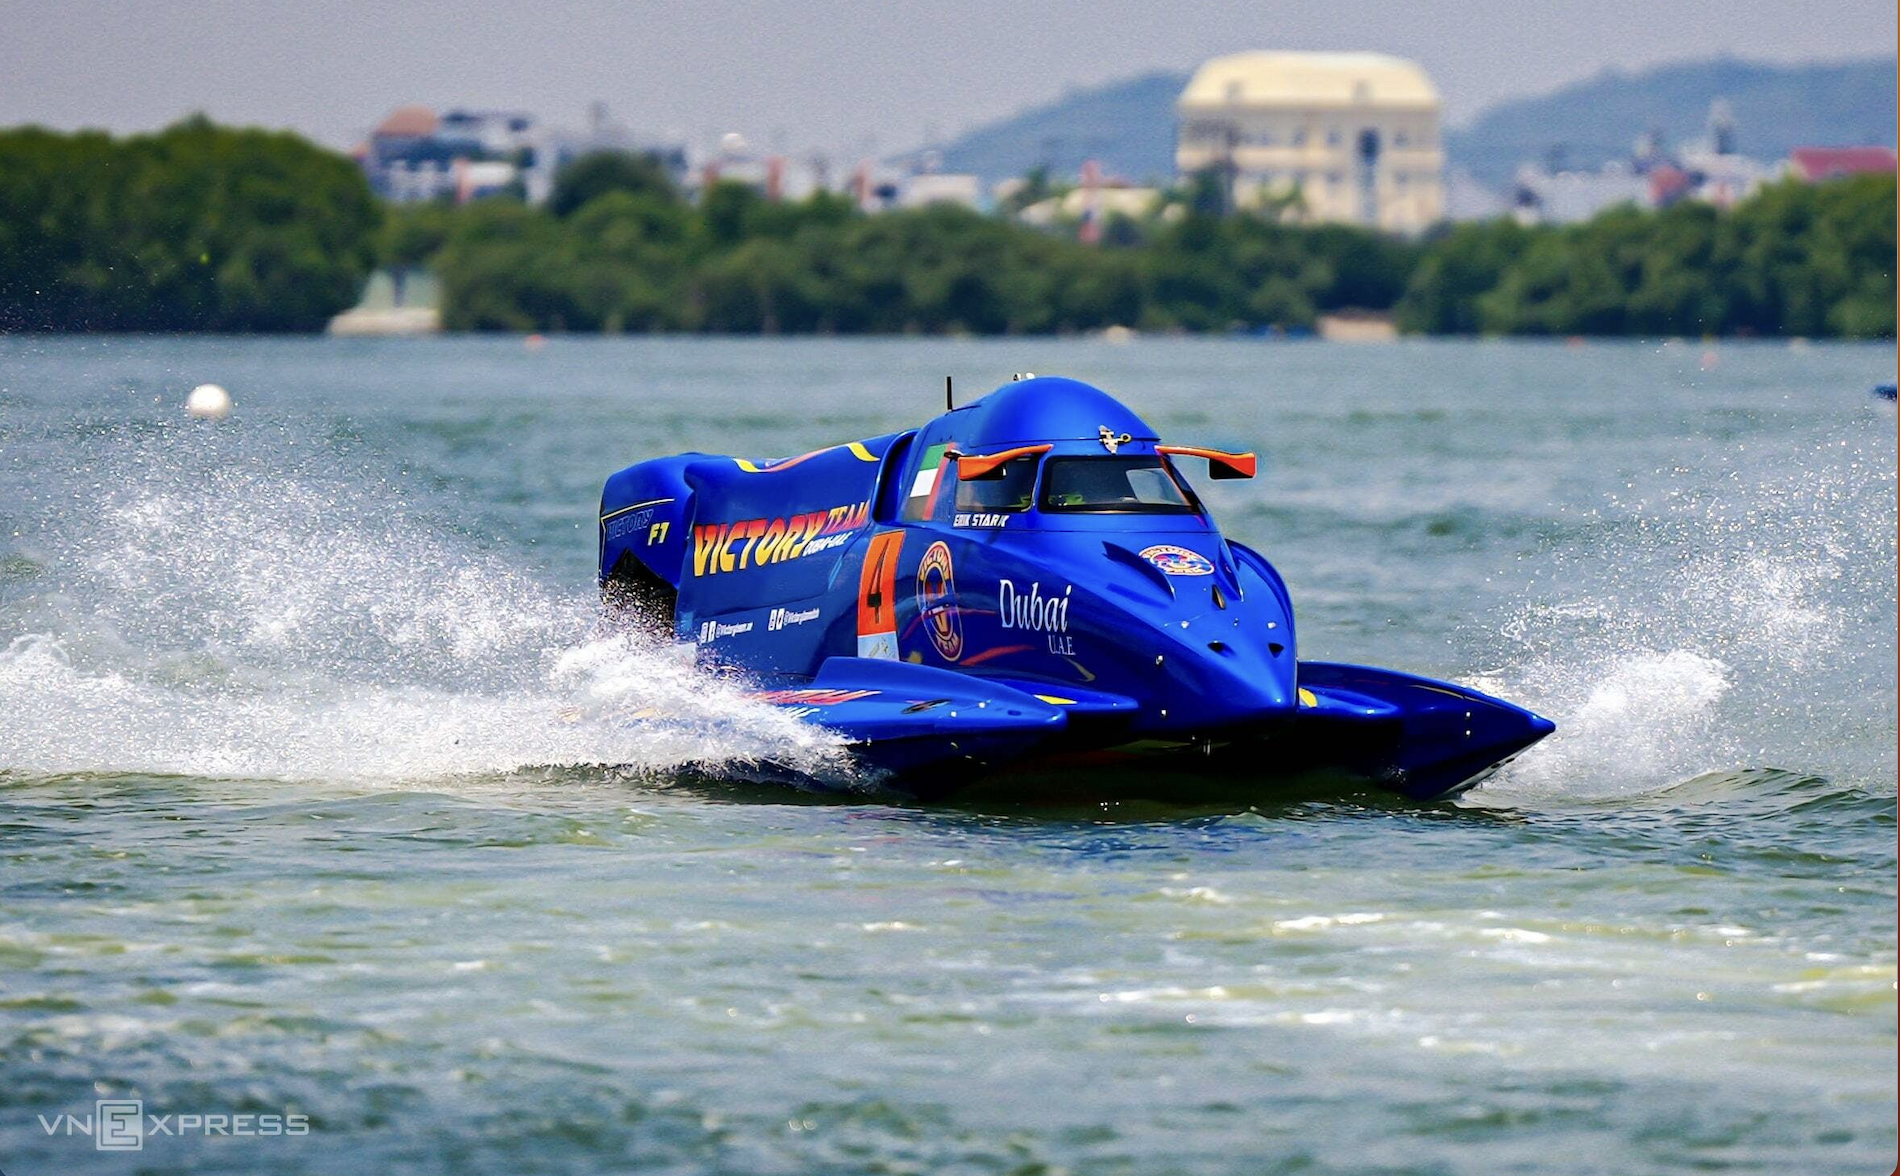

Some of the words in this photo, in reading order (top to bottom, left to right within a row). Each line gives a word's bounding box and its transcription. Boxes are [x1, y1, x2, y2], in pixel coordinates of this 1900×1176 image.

[647, 522, 671, 546] F1
[693, 510, 828, 578] VICTORY
[820, 500, 870, 535] TEAM
[953, 513, 971, 527] ERIK
[971, 513, 1010, 527] STARK
[867, 538, 883, 624] 4
[1000, 579, 1072, 633] Dubai
